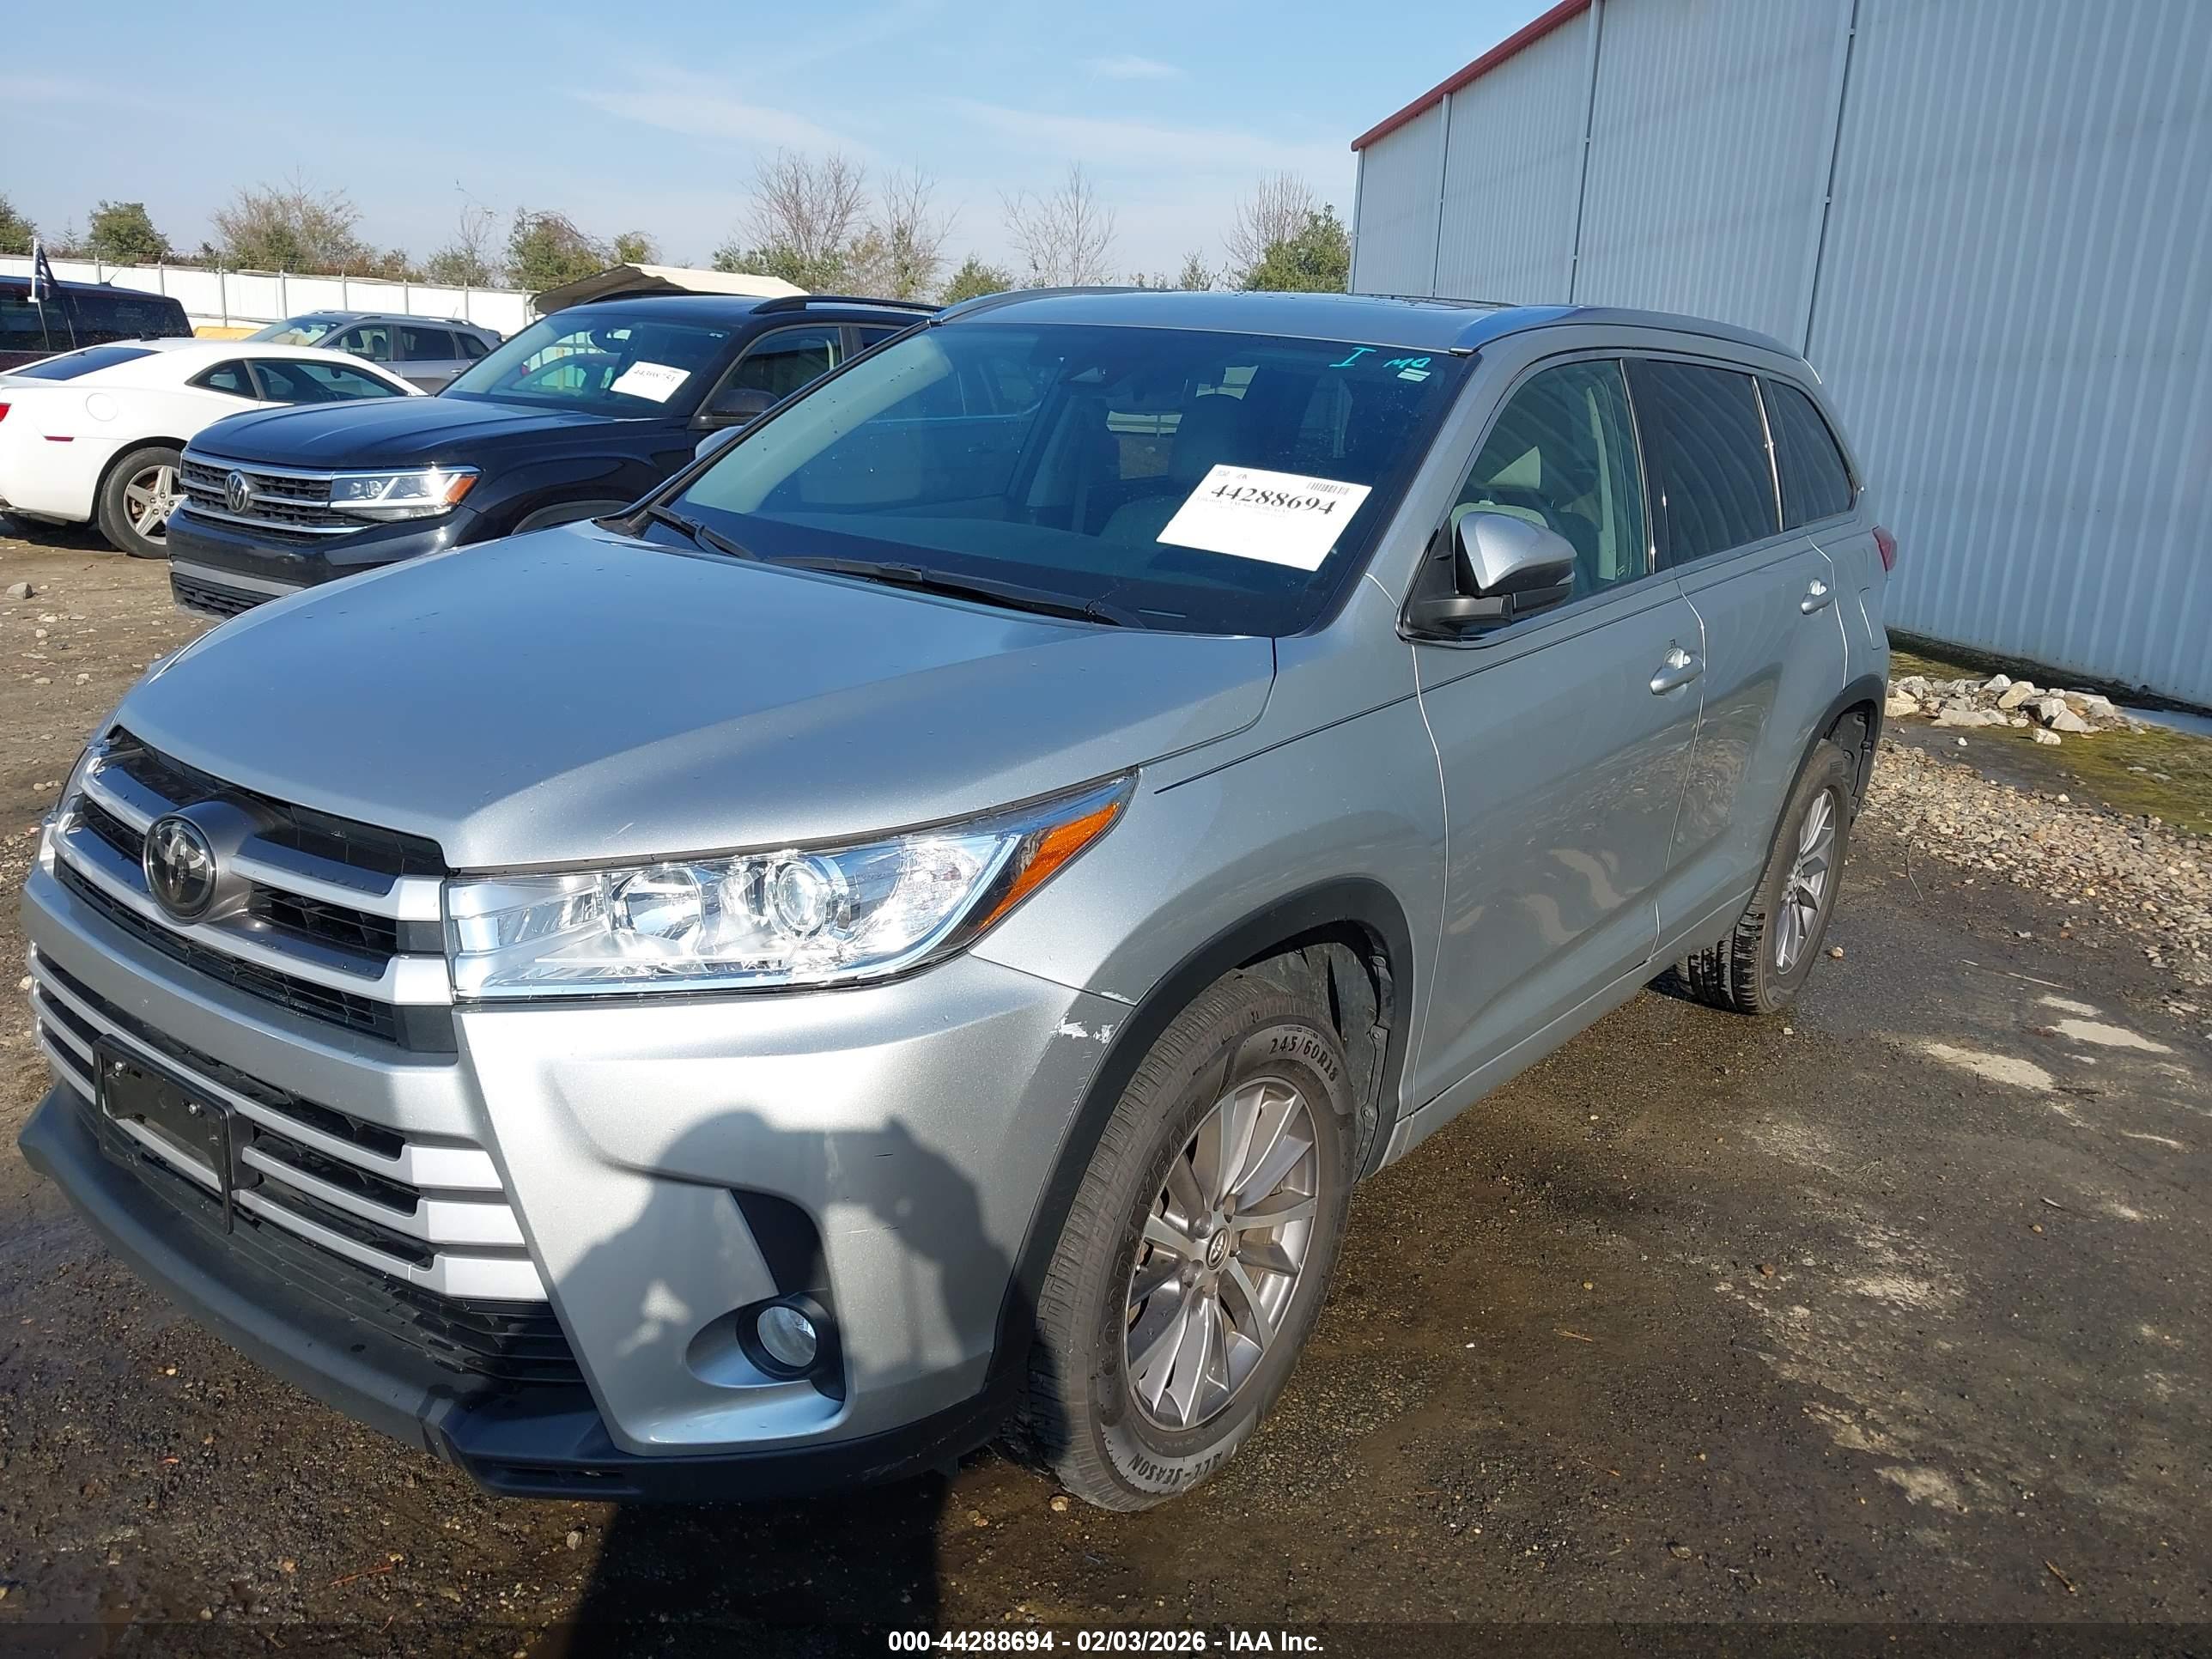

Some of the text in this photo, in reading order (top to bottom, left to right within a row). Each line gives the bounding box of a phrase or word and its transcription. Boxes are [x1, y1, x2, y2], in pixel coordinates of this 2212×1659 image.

[1211, 483, 1338, 515] 44288694
[1269, 1036, 1340, 1082] 245/60R18
[1127, 1450, 1224, 1487] ALL-SEASON
